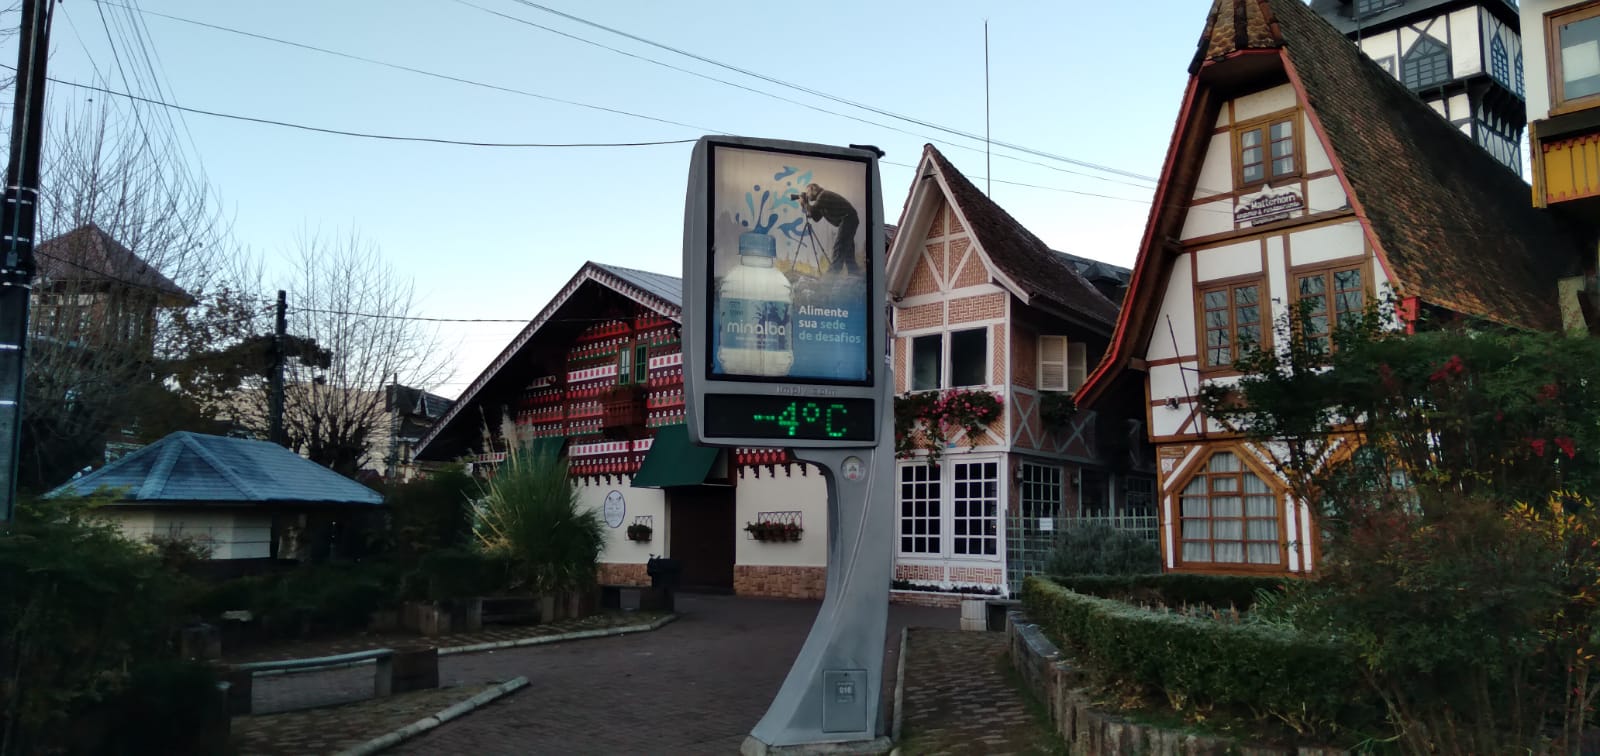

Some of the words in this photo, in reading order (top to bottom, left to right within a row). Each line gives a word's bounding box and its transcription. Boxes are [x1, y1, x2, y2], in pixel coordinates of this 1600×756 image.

[1251, 194, 1296, 209] Matterhorn
[798, 305, 849, 318] Alimente
[727, 319, 785, 336] minalba
[798, 319, 818, 329] sua
[820, 319, 846, 330] sede
[798, 330, 813, 341] de
[815, 331, 862, 344] desafios
